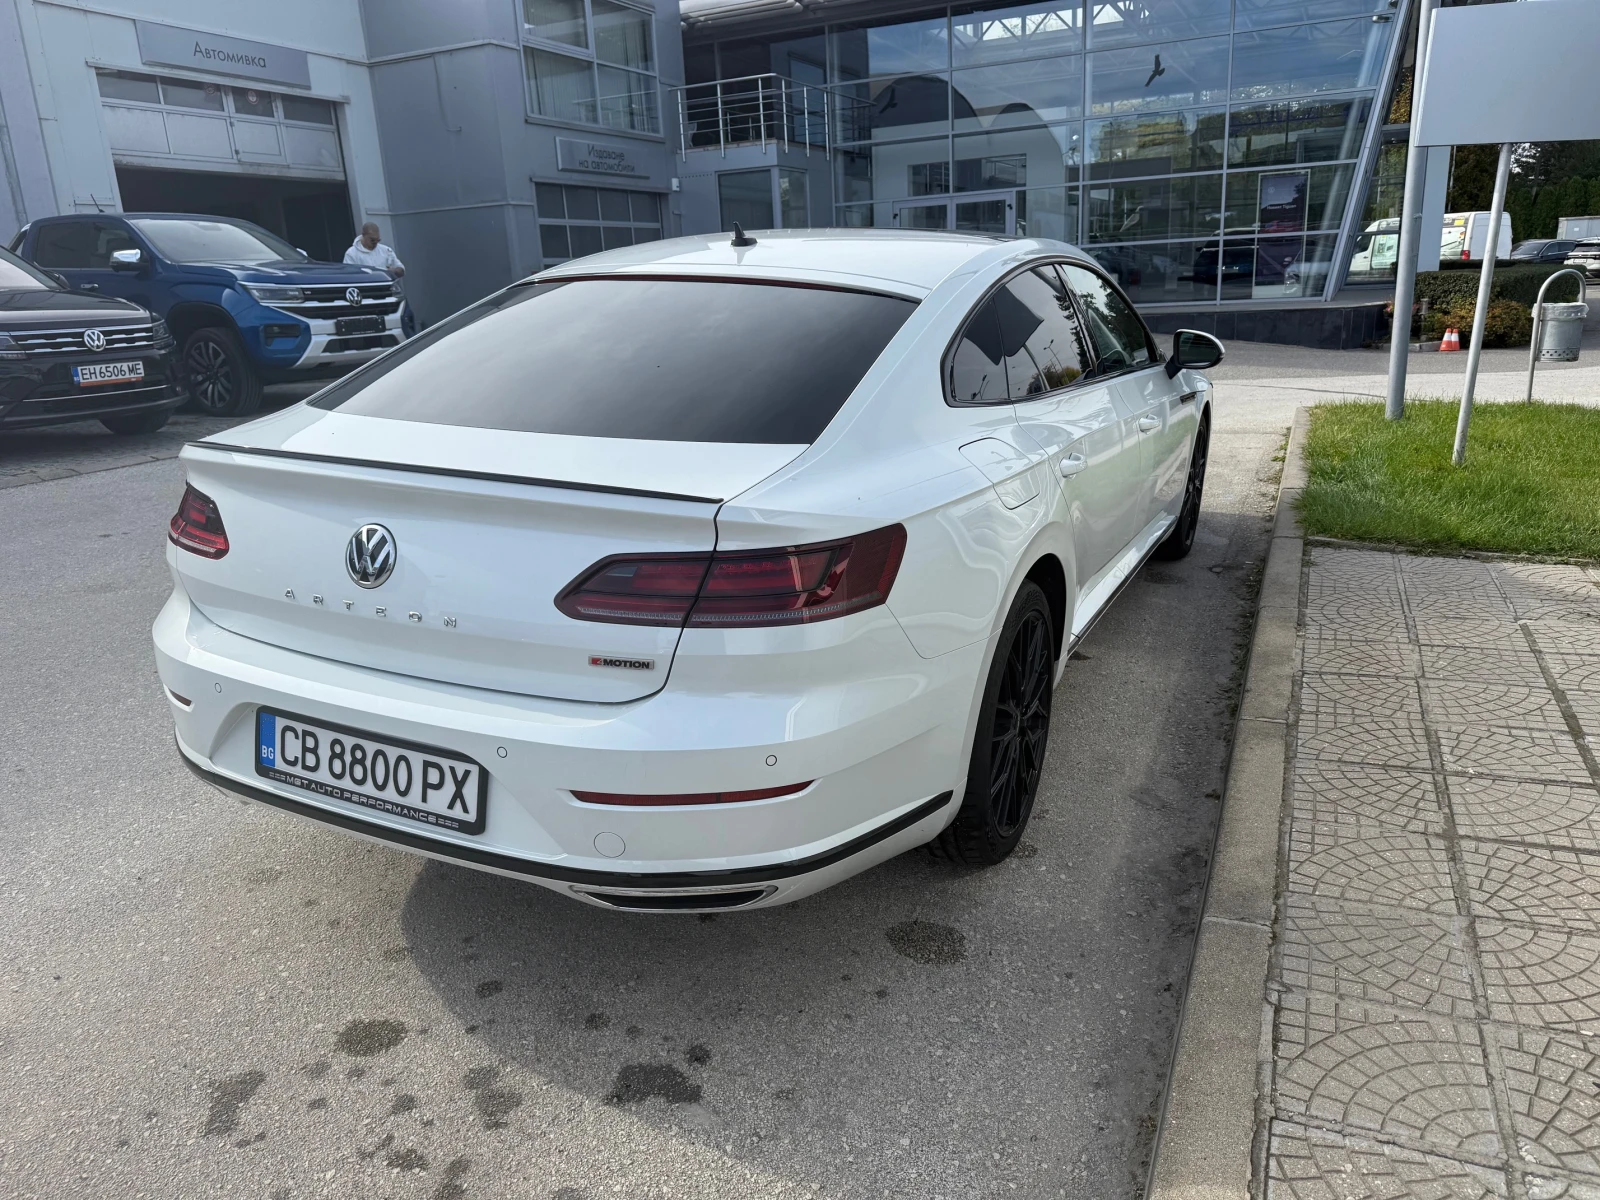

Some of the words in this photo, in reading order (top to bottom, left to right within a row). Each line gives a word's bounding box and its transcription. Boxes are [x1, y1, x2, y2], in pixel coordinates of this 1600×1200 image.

[193, 41, 267, 68] Автомивка
[587, 143, 625, 161] Издаване
[578, 159, 589, 169] на
[590, 160, 636, 173] автомобили
[80, 366, 98, 380] EH
[99, 364, 127, 379] 6506
[127, 362, 143, 376] ME
[285, 587, 457, 628] ARTEON
[261, 744, 275, 760] BG
[280, 724, 321, 773] CB
[328, 738, 413, 798] 8800
[421, 759, 472, 815] PX
[310, 782, 341, 797] AUTO
[343, 791, 438, 824] PERFORMANCE
